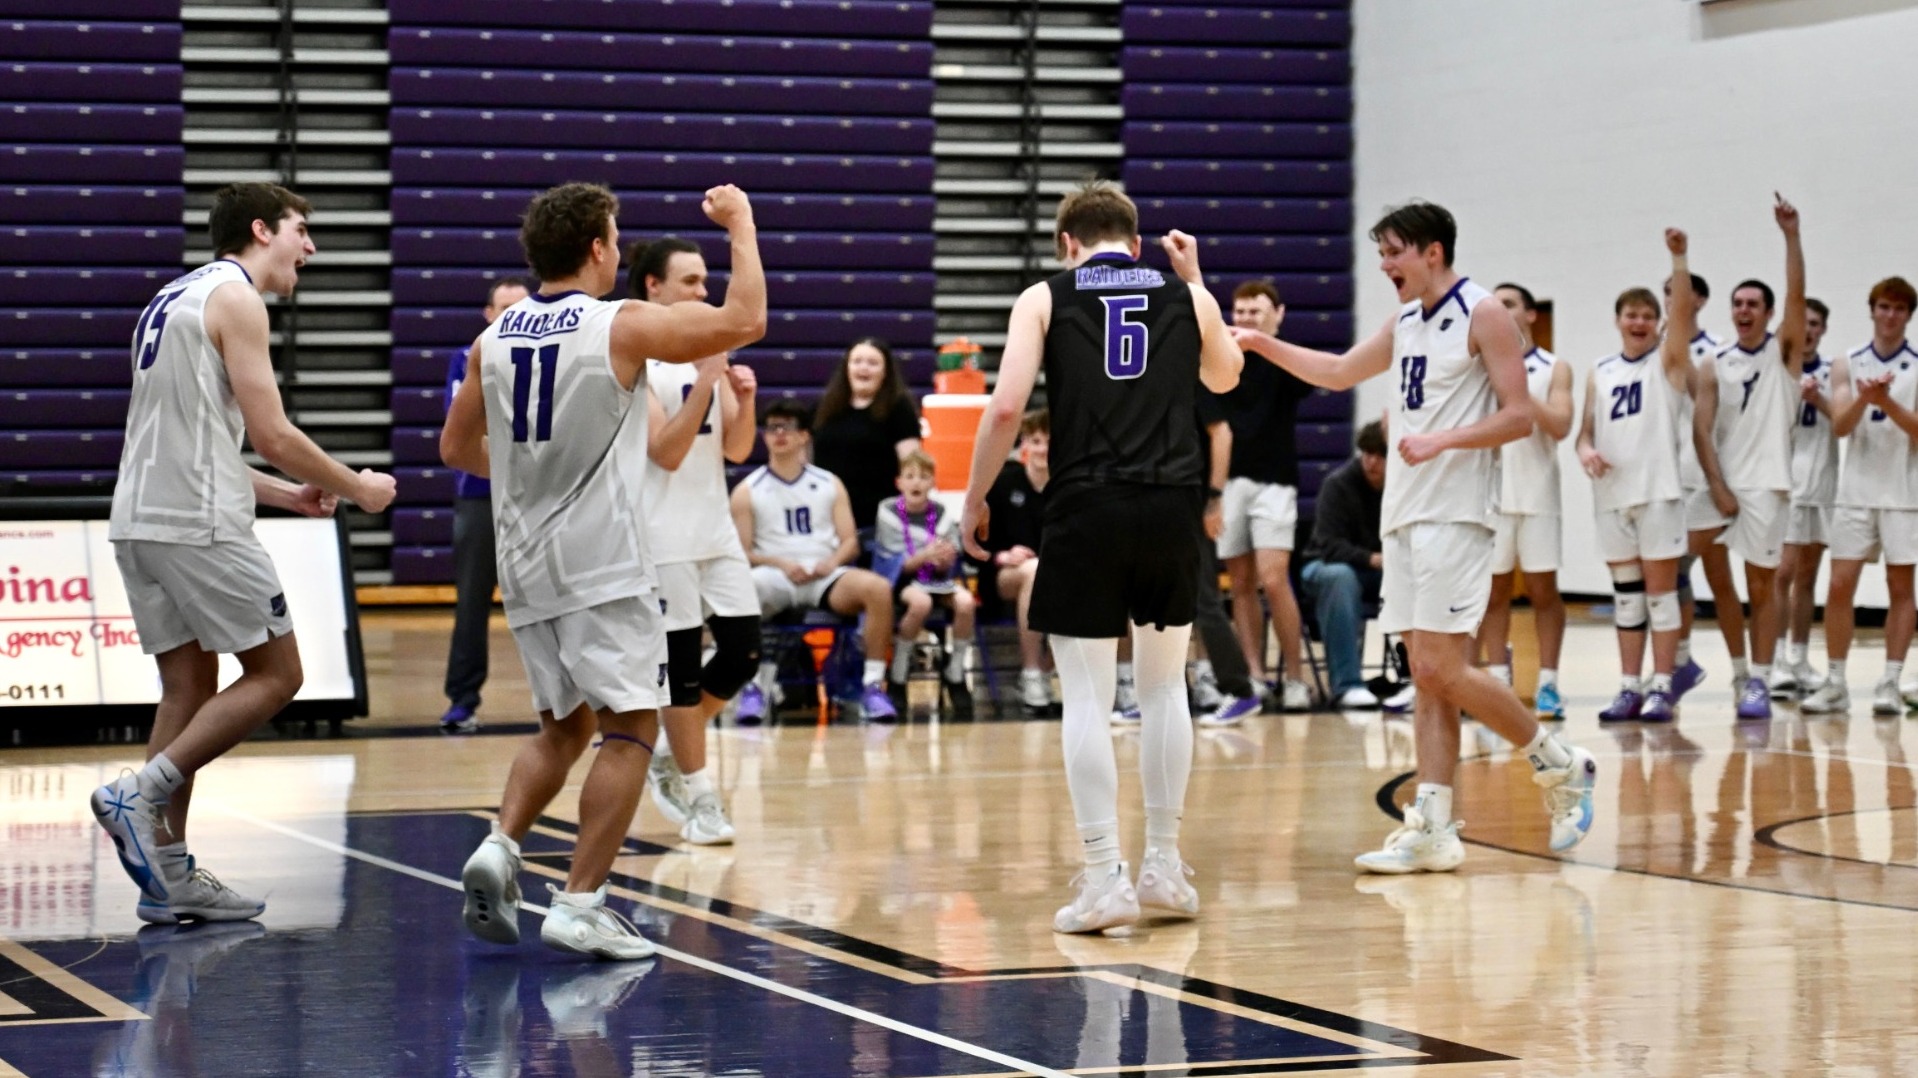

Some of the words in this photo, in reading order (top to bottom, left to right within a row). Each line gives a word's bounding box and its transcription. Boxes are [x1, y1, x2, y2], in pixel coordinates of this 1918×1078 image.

[499, 306, 584, 338] RAIDERS
[1098, 294, 1149, 380] 6
[510, 343, 560, 442] 11
[1400, 355, 1428, 412] 18
[1610, 380, 1643, 421] 20
[784, 506, 812, 535] 10
